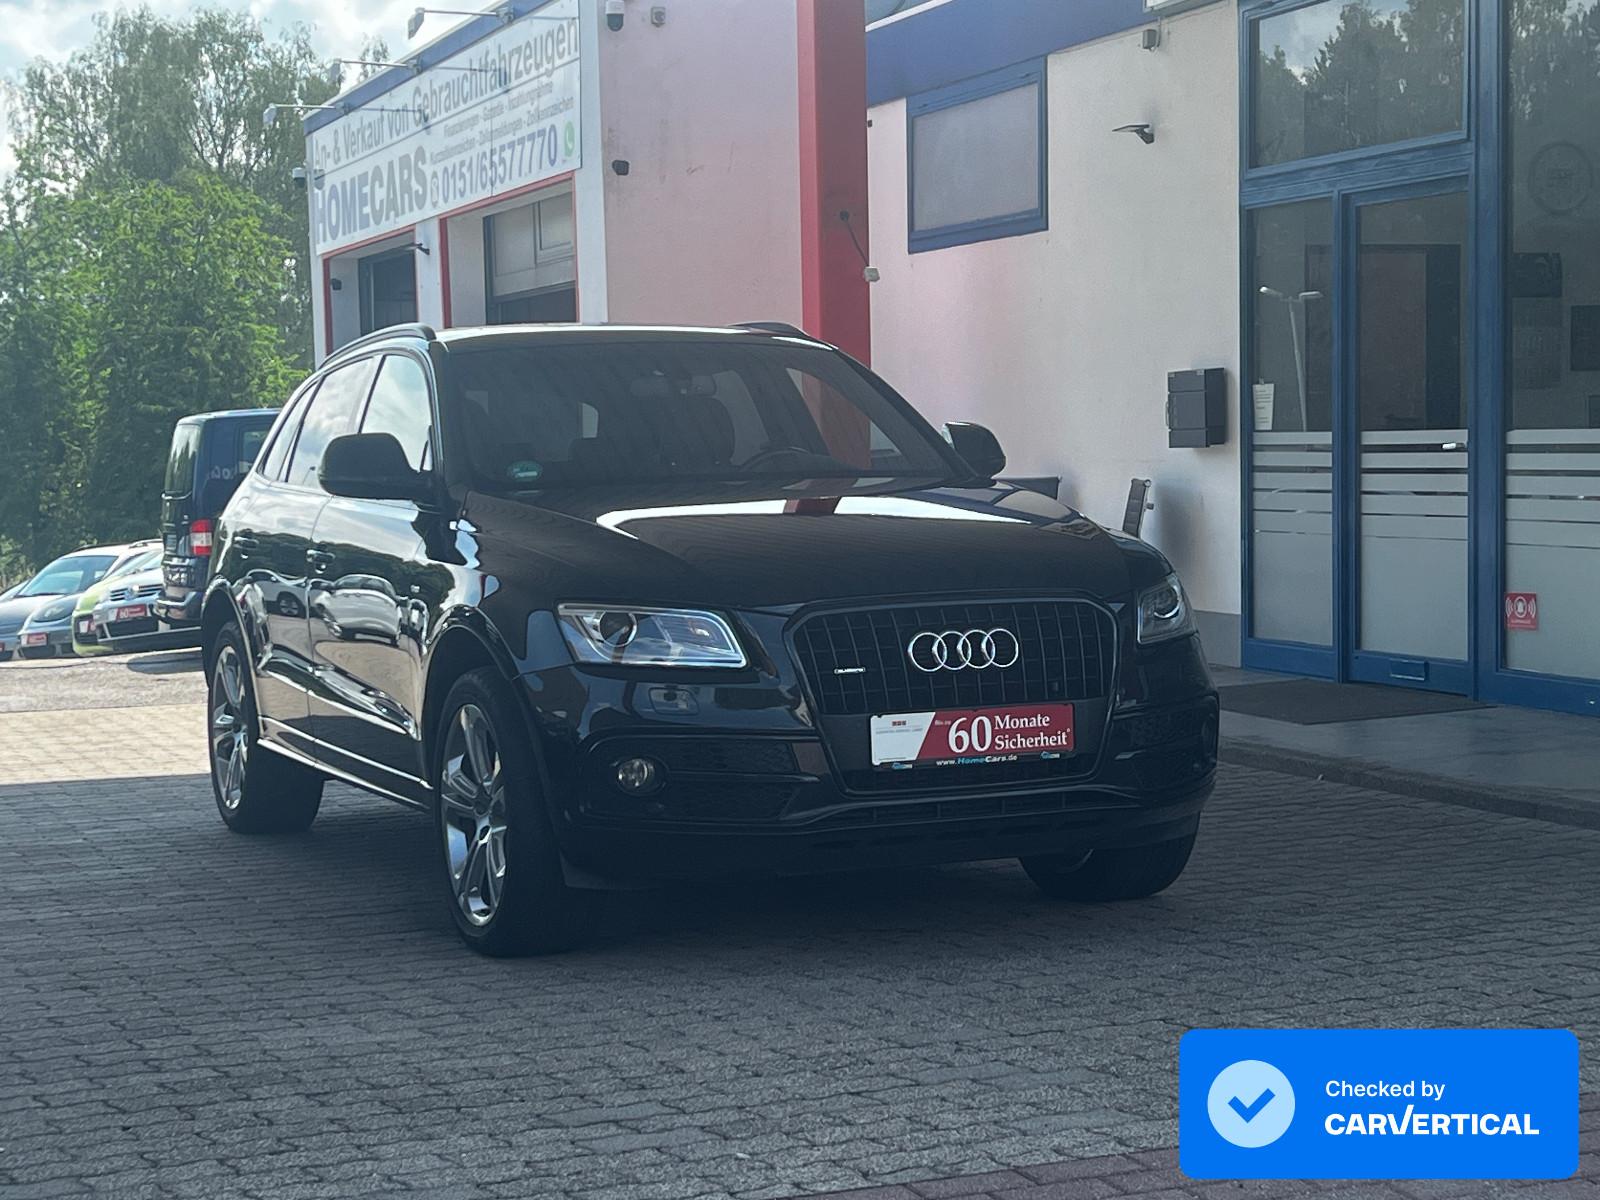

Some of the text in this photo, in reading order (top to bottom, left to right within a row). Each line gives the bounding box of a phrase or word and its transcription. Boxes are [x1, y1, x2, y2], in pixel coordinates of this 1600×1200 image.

[333, 128, 341, 165] &
[343, 113, 385, 160] Verkauf
[387, 104, 409, 140] von
[412, 18, 578, 126] Gebrauchtfahrzeugen
[314, 145, 428, 245] HOMECARS
[442, 124, 558, 204] 0151/65577770
[936, 753, 1018, 766] www.HomeCars.de
[948, 715, 992, 753] 60
[994, 713, 1050, 730] Monate
